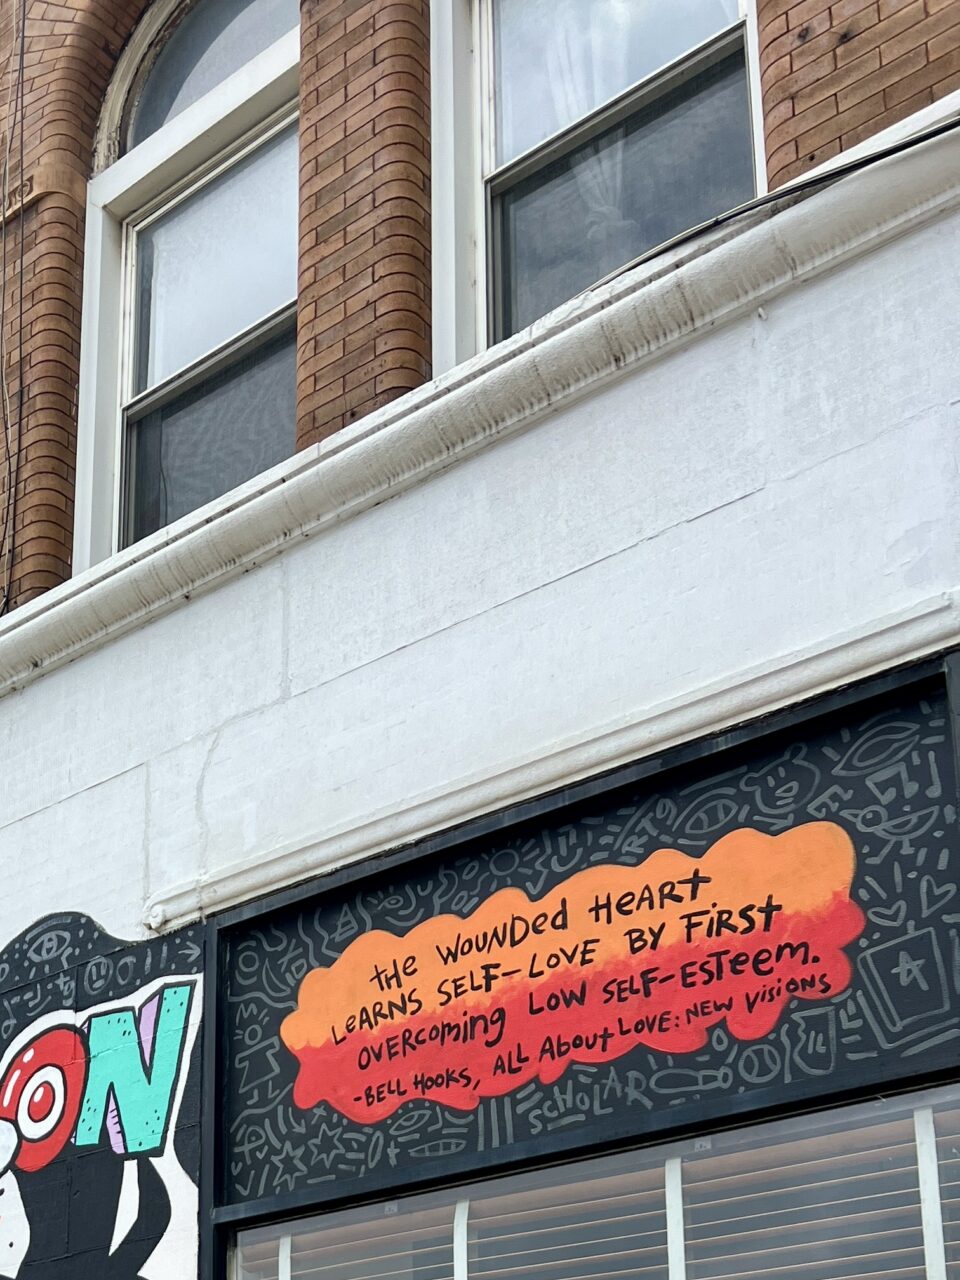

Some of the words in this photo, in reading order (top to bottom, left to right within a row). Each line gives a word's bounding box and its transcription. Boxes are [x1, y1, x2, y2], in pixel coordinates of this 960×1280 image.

[624, 922, 665, 954] BY
[528, 980, 587, 1016] LOW
[493, 1042, 529, 1076] ALL
[686, 997, 733, 1025] NEW
